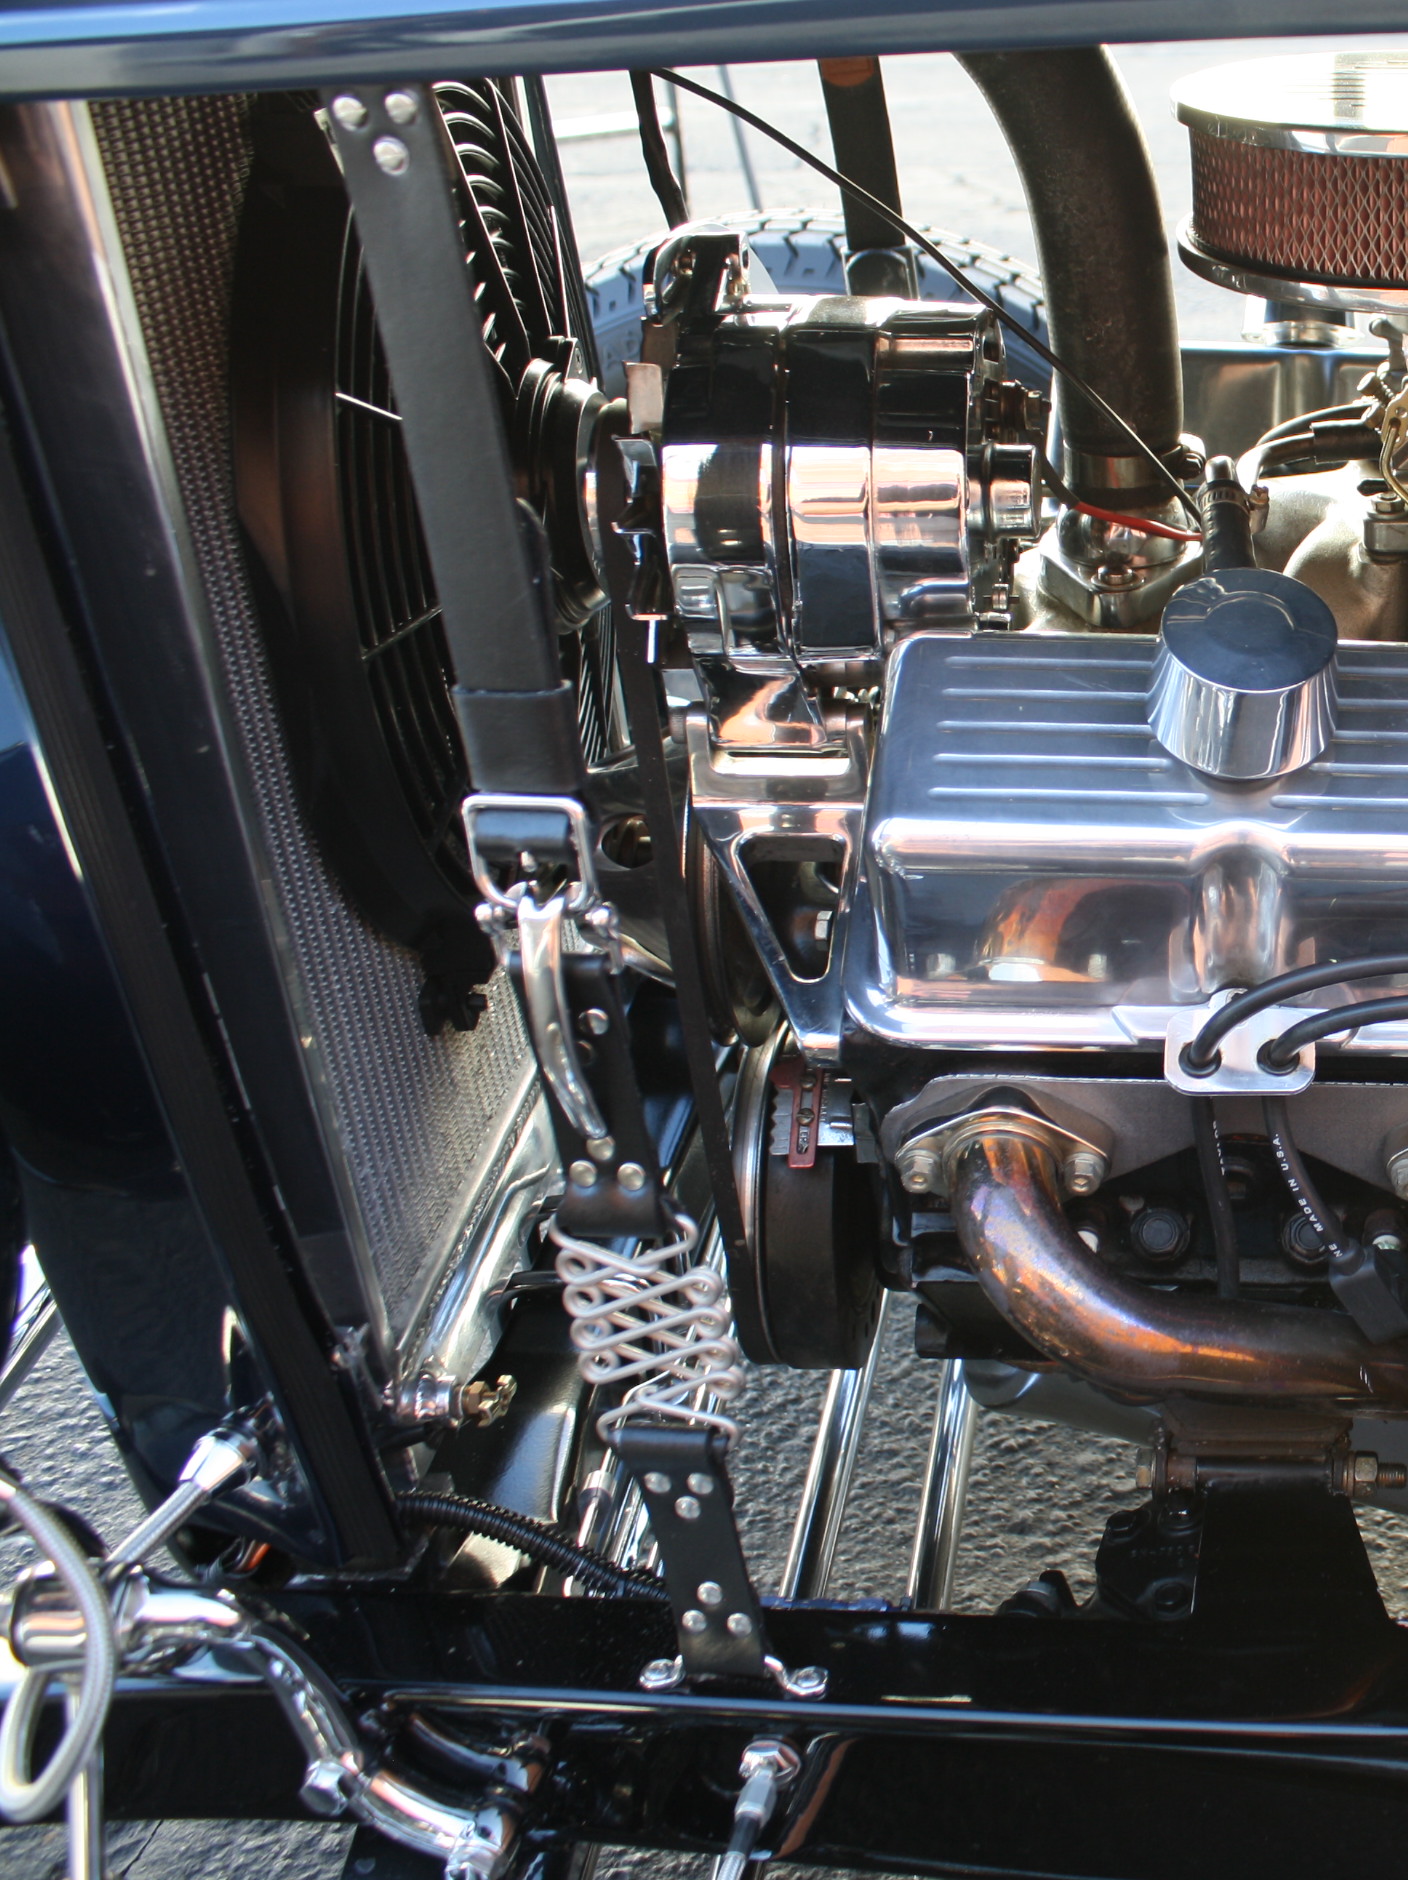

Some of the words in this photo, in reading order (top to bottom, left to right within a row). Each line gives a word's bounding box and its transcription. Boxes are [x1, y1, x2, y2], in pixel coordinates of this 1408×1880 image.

[1272, 1133, 1290, 1171] U.S.A.
[1288, 1178, 1300, 1192] IN
[1298, 1198, 1324, 1233] MADE
